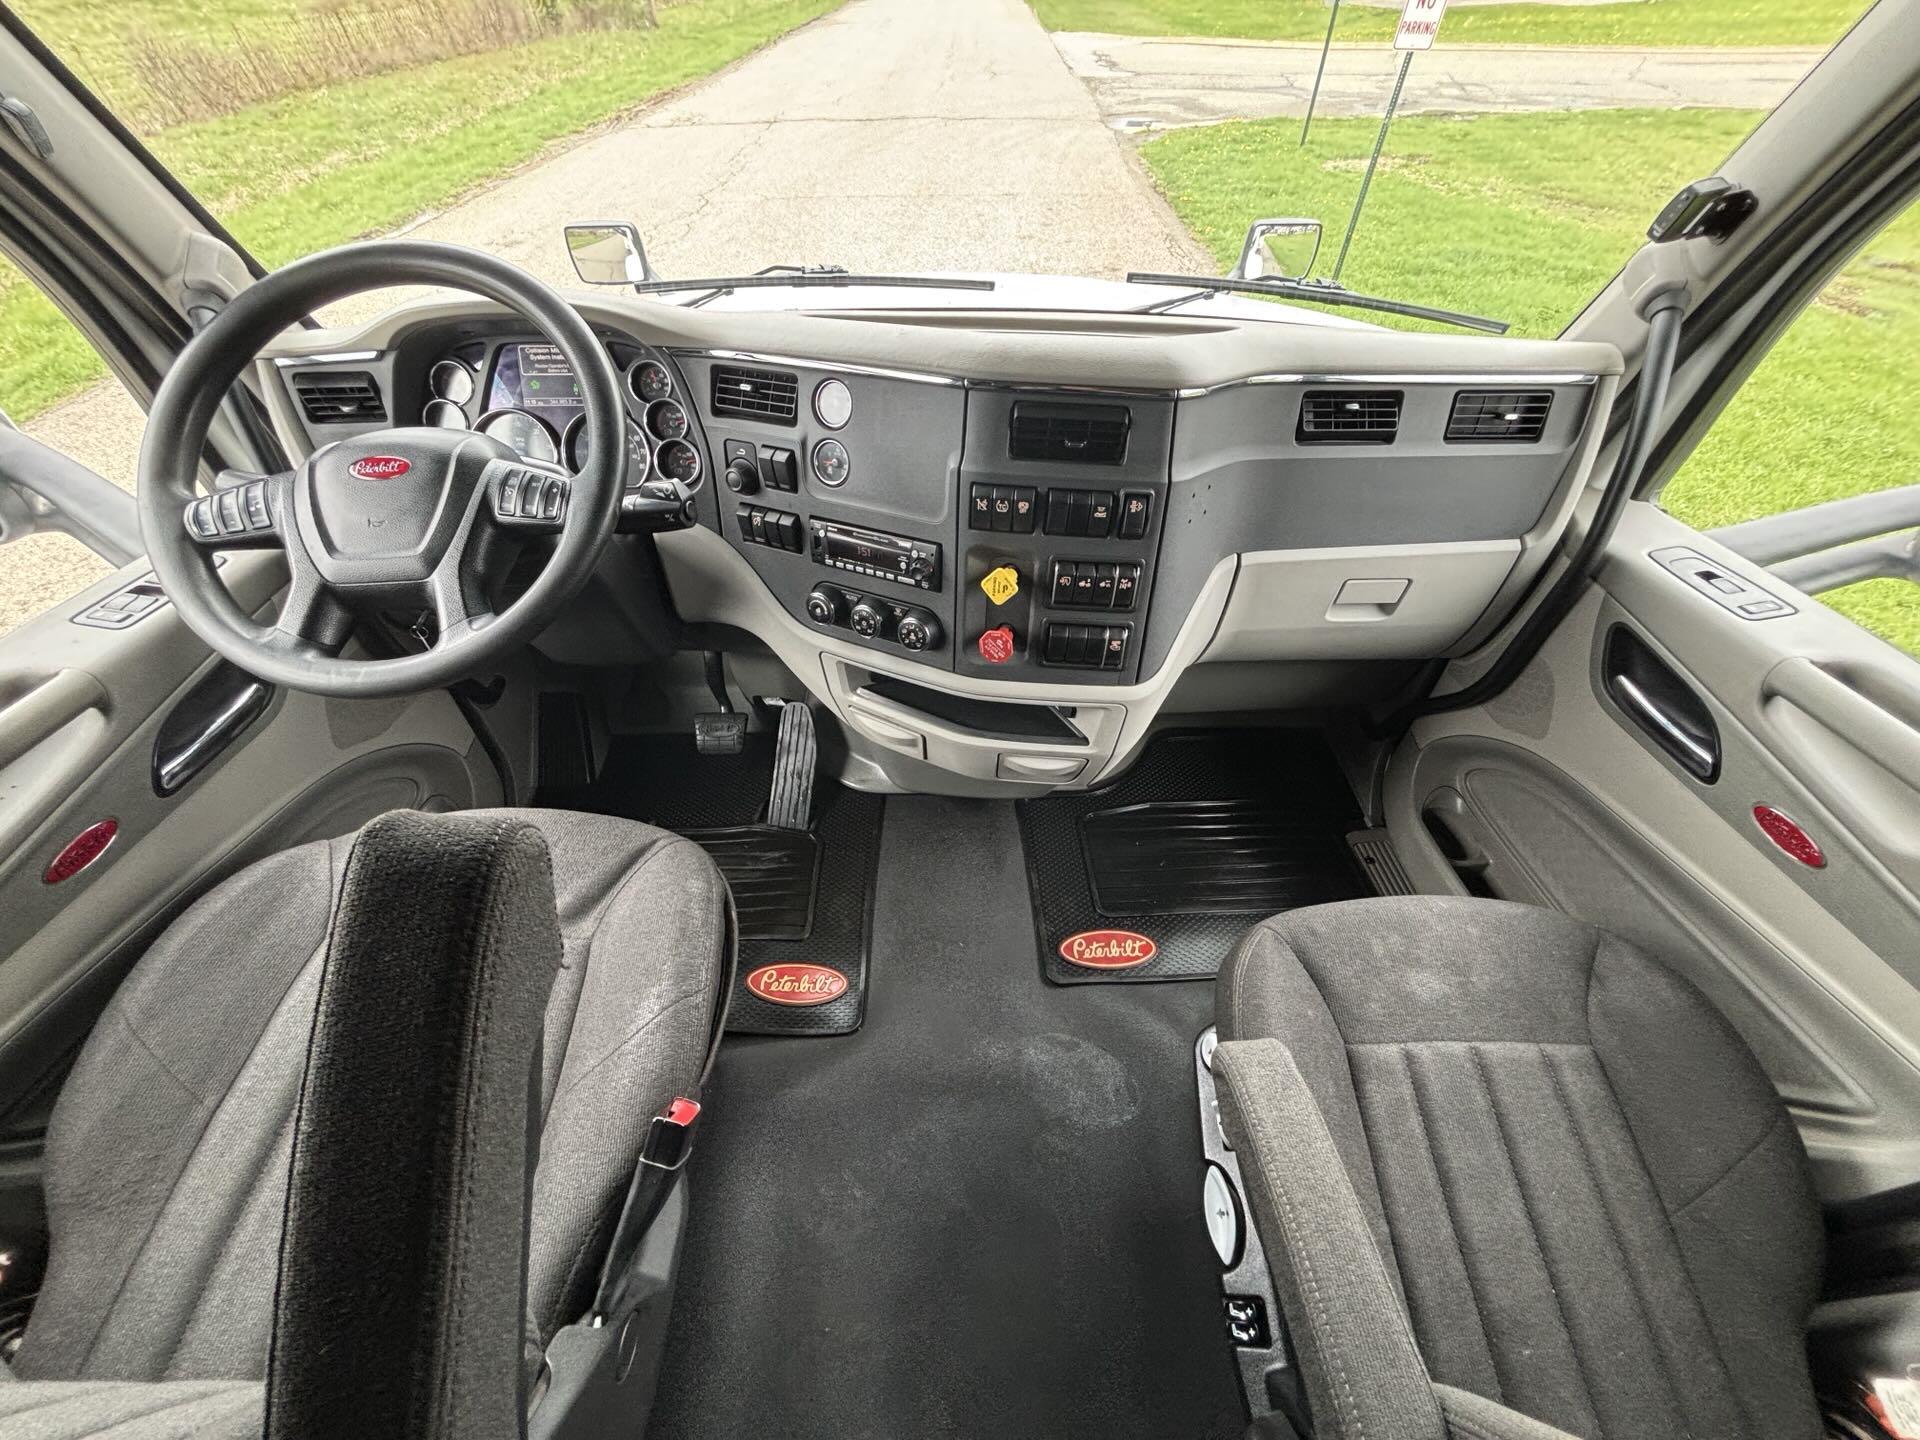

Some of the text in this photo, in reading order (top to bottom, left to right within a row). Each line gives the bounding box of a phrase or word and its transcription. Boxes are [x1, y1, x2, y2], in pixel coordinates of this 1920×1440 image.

[1400, 21, 1436, 35] PARKING
[355, 460, 404, 474] Peterbilt
[1072, 938, 1147, 959] Peterbilt
[760, 969, 839, 993] Peterbilt
